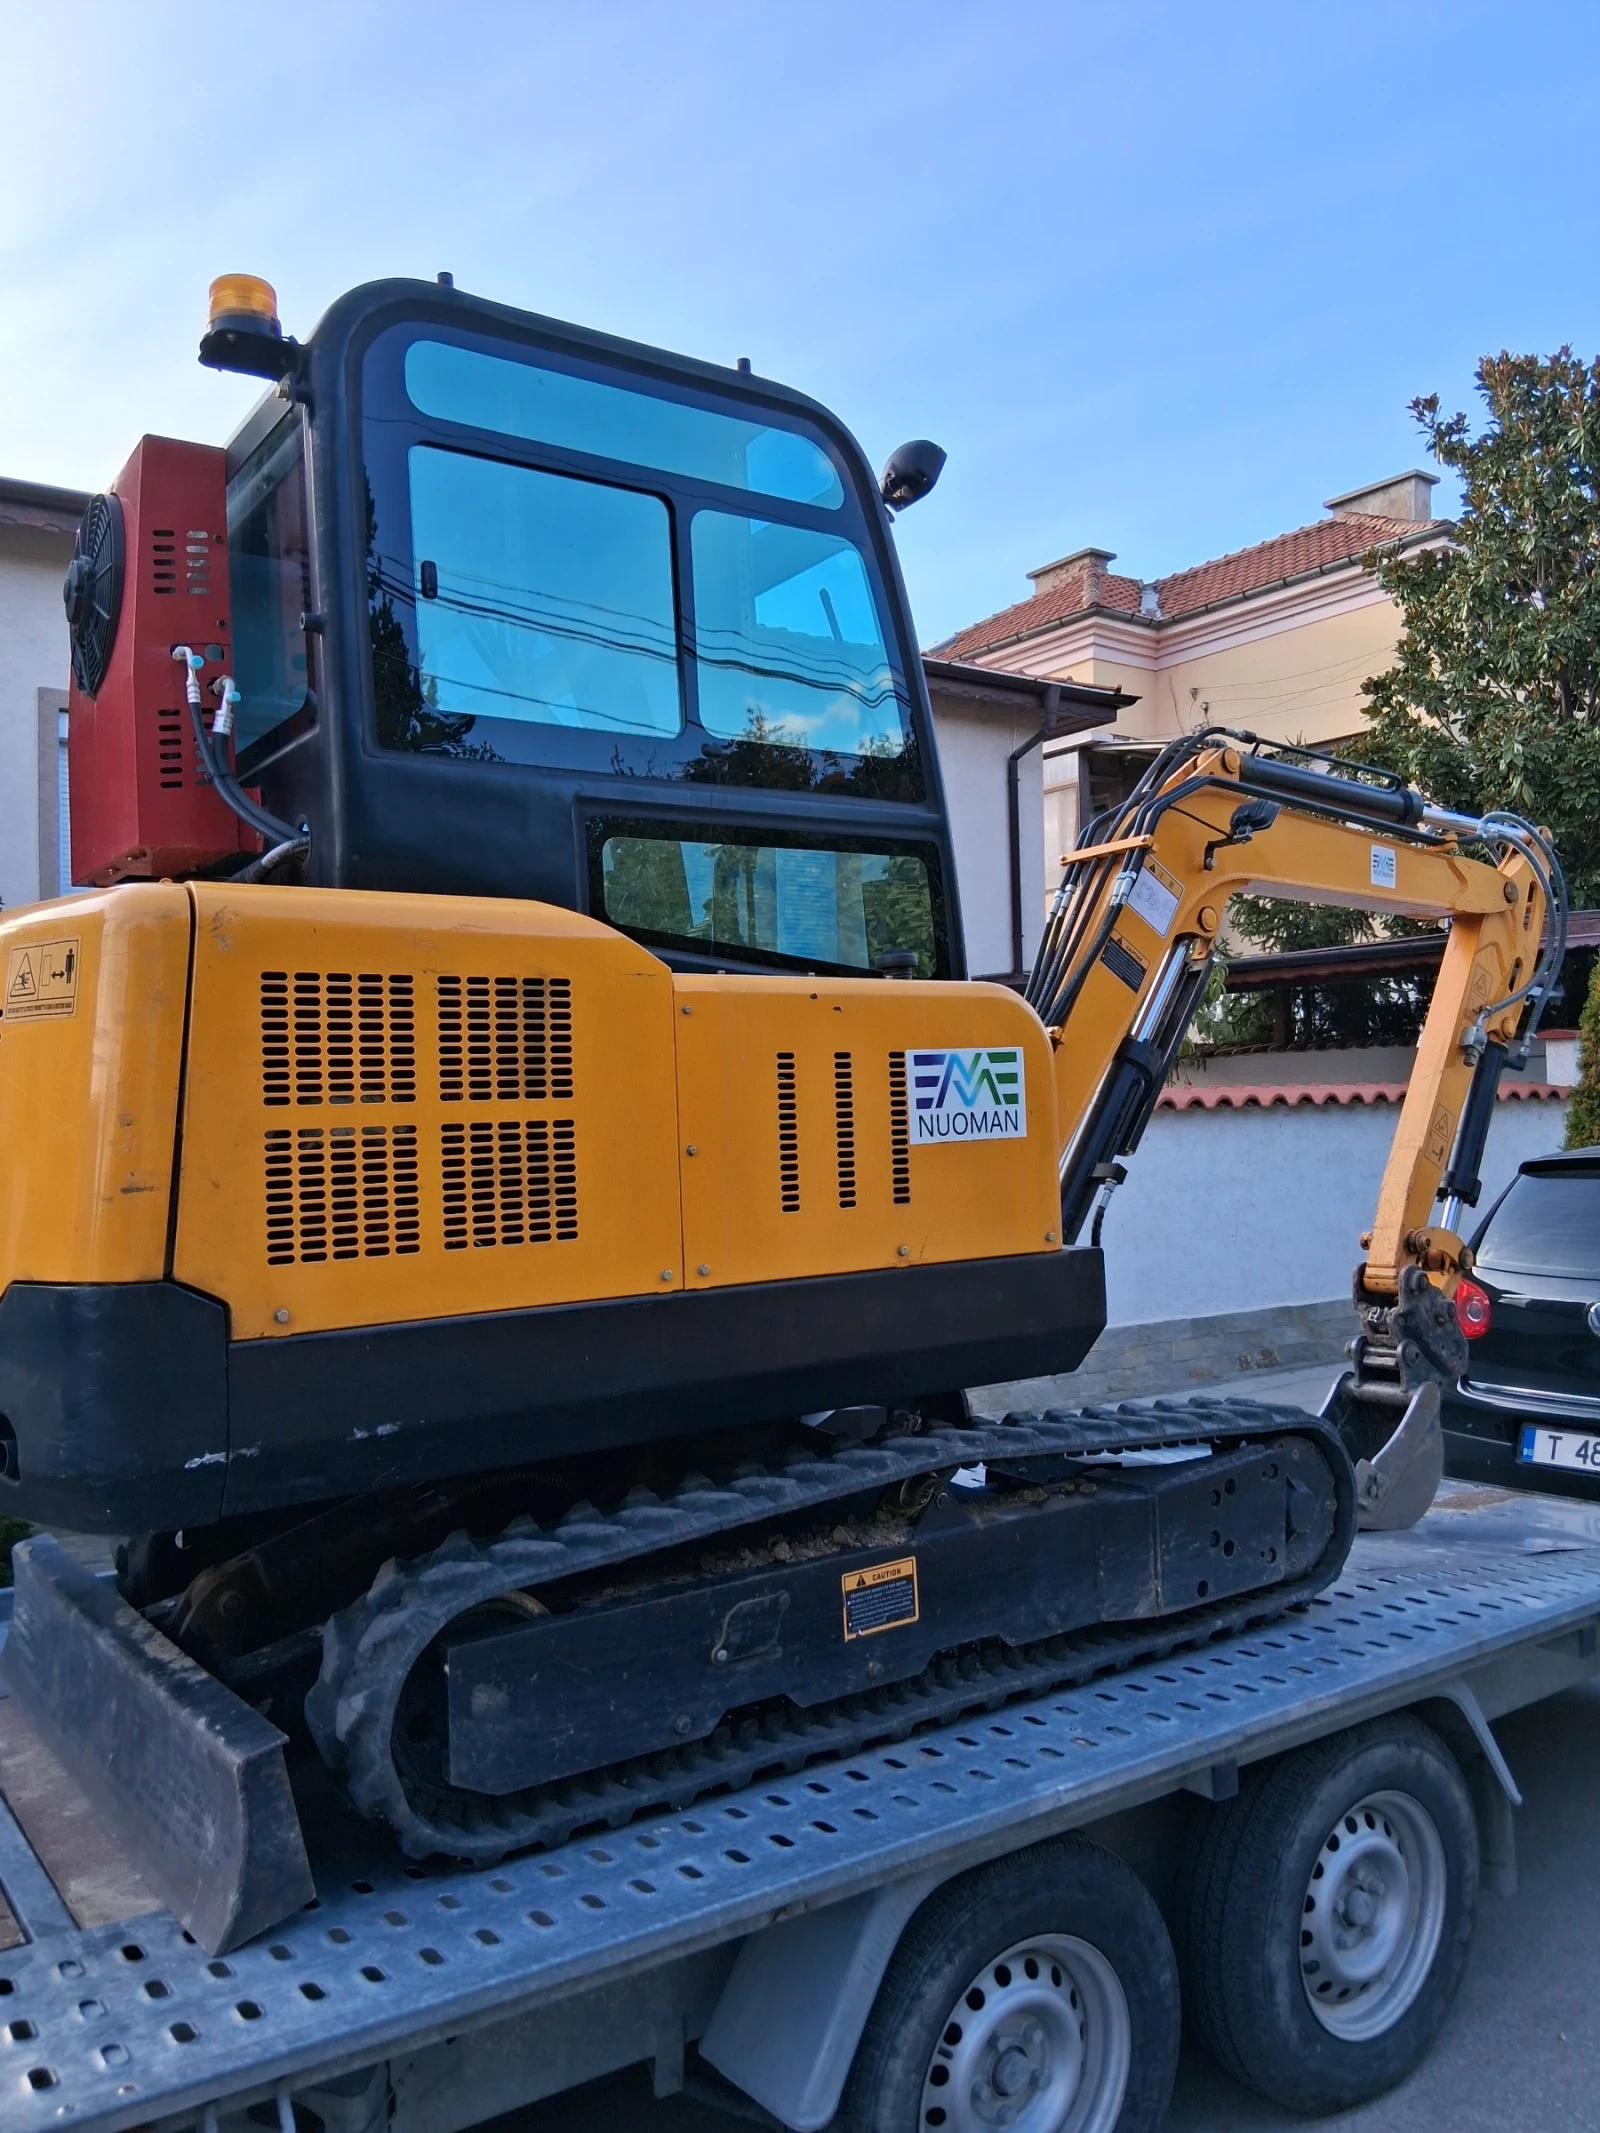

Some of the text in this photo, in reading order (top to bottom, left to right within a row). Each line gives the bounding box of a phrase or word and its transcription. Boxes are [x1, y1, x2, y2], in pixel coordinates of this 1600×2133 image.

[1373, 869, 1394, 878] NUOMAN
[1126, 945, 1143, 962] CAUTION
[919, 1109, 1018, 1137] NUOMAN
[1523, 1447, 1533, 1456] BG
[1548, 1435, 1563, 1460] T
[872, 1567, 902, 1581] CAUTION
